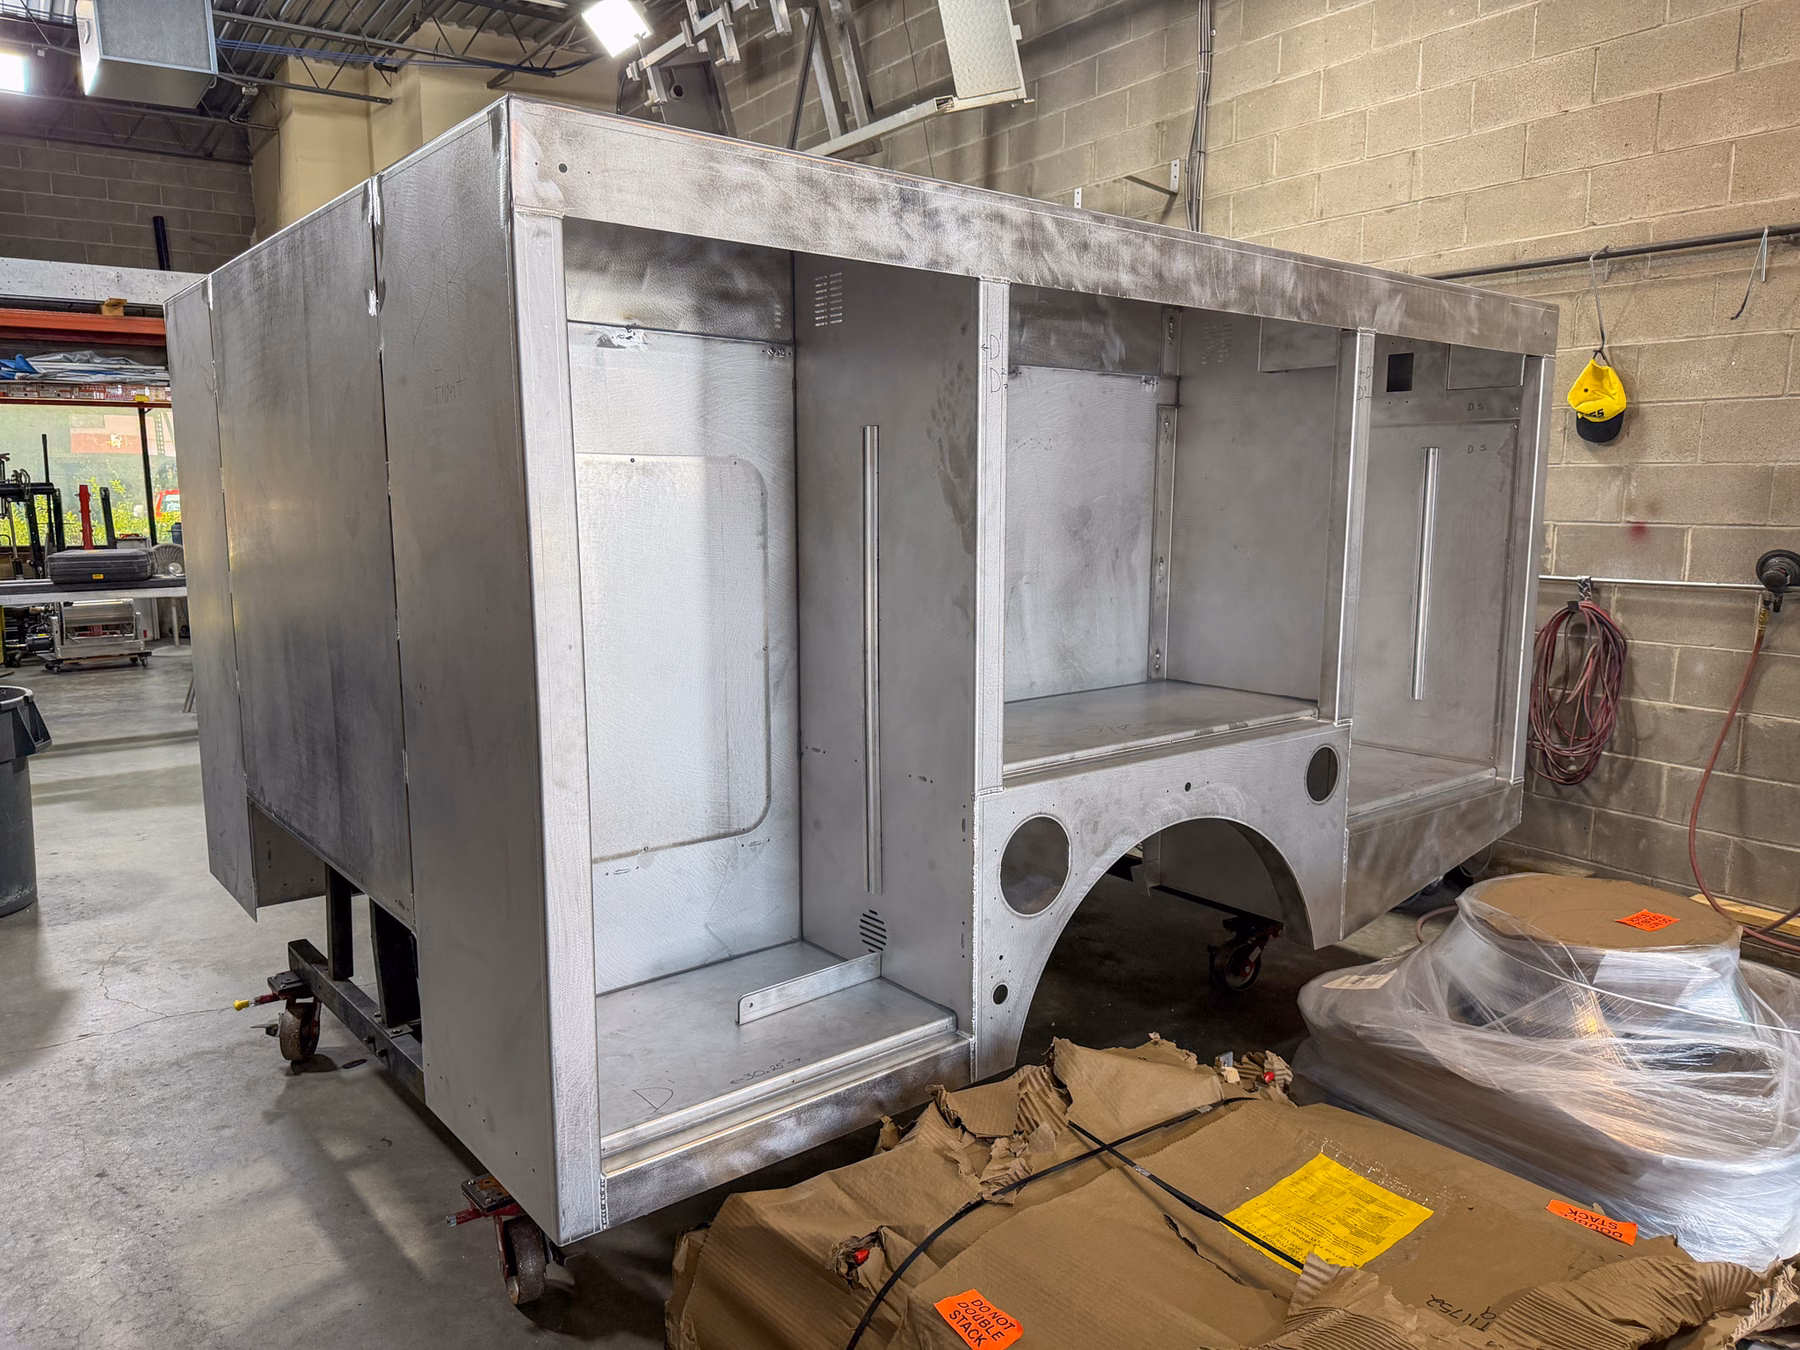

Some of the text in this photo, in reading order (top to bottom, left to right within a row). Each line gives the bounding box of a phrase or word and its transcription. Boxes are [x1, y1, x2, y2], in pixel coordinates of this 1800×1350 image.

[1568, 1207, 1619, 1230] STACK
[948, 1309, 988, 1347] STACK
[957, 1301, 1005, 1342] DOUBLE
[971, 1299, 1016, 1331] DO NOT
